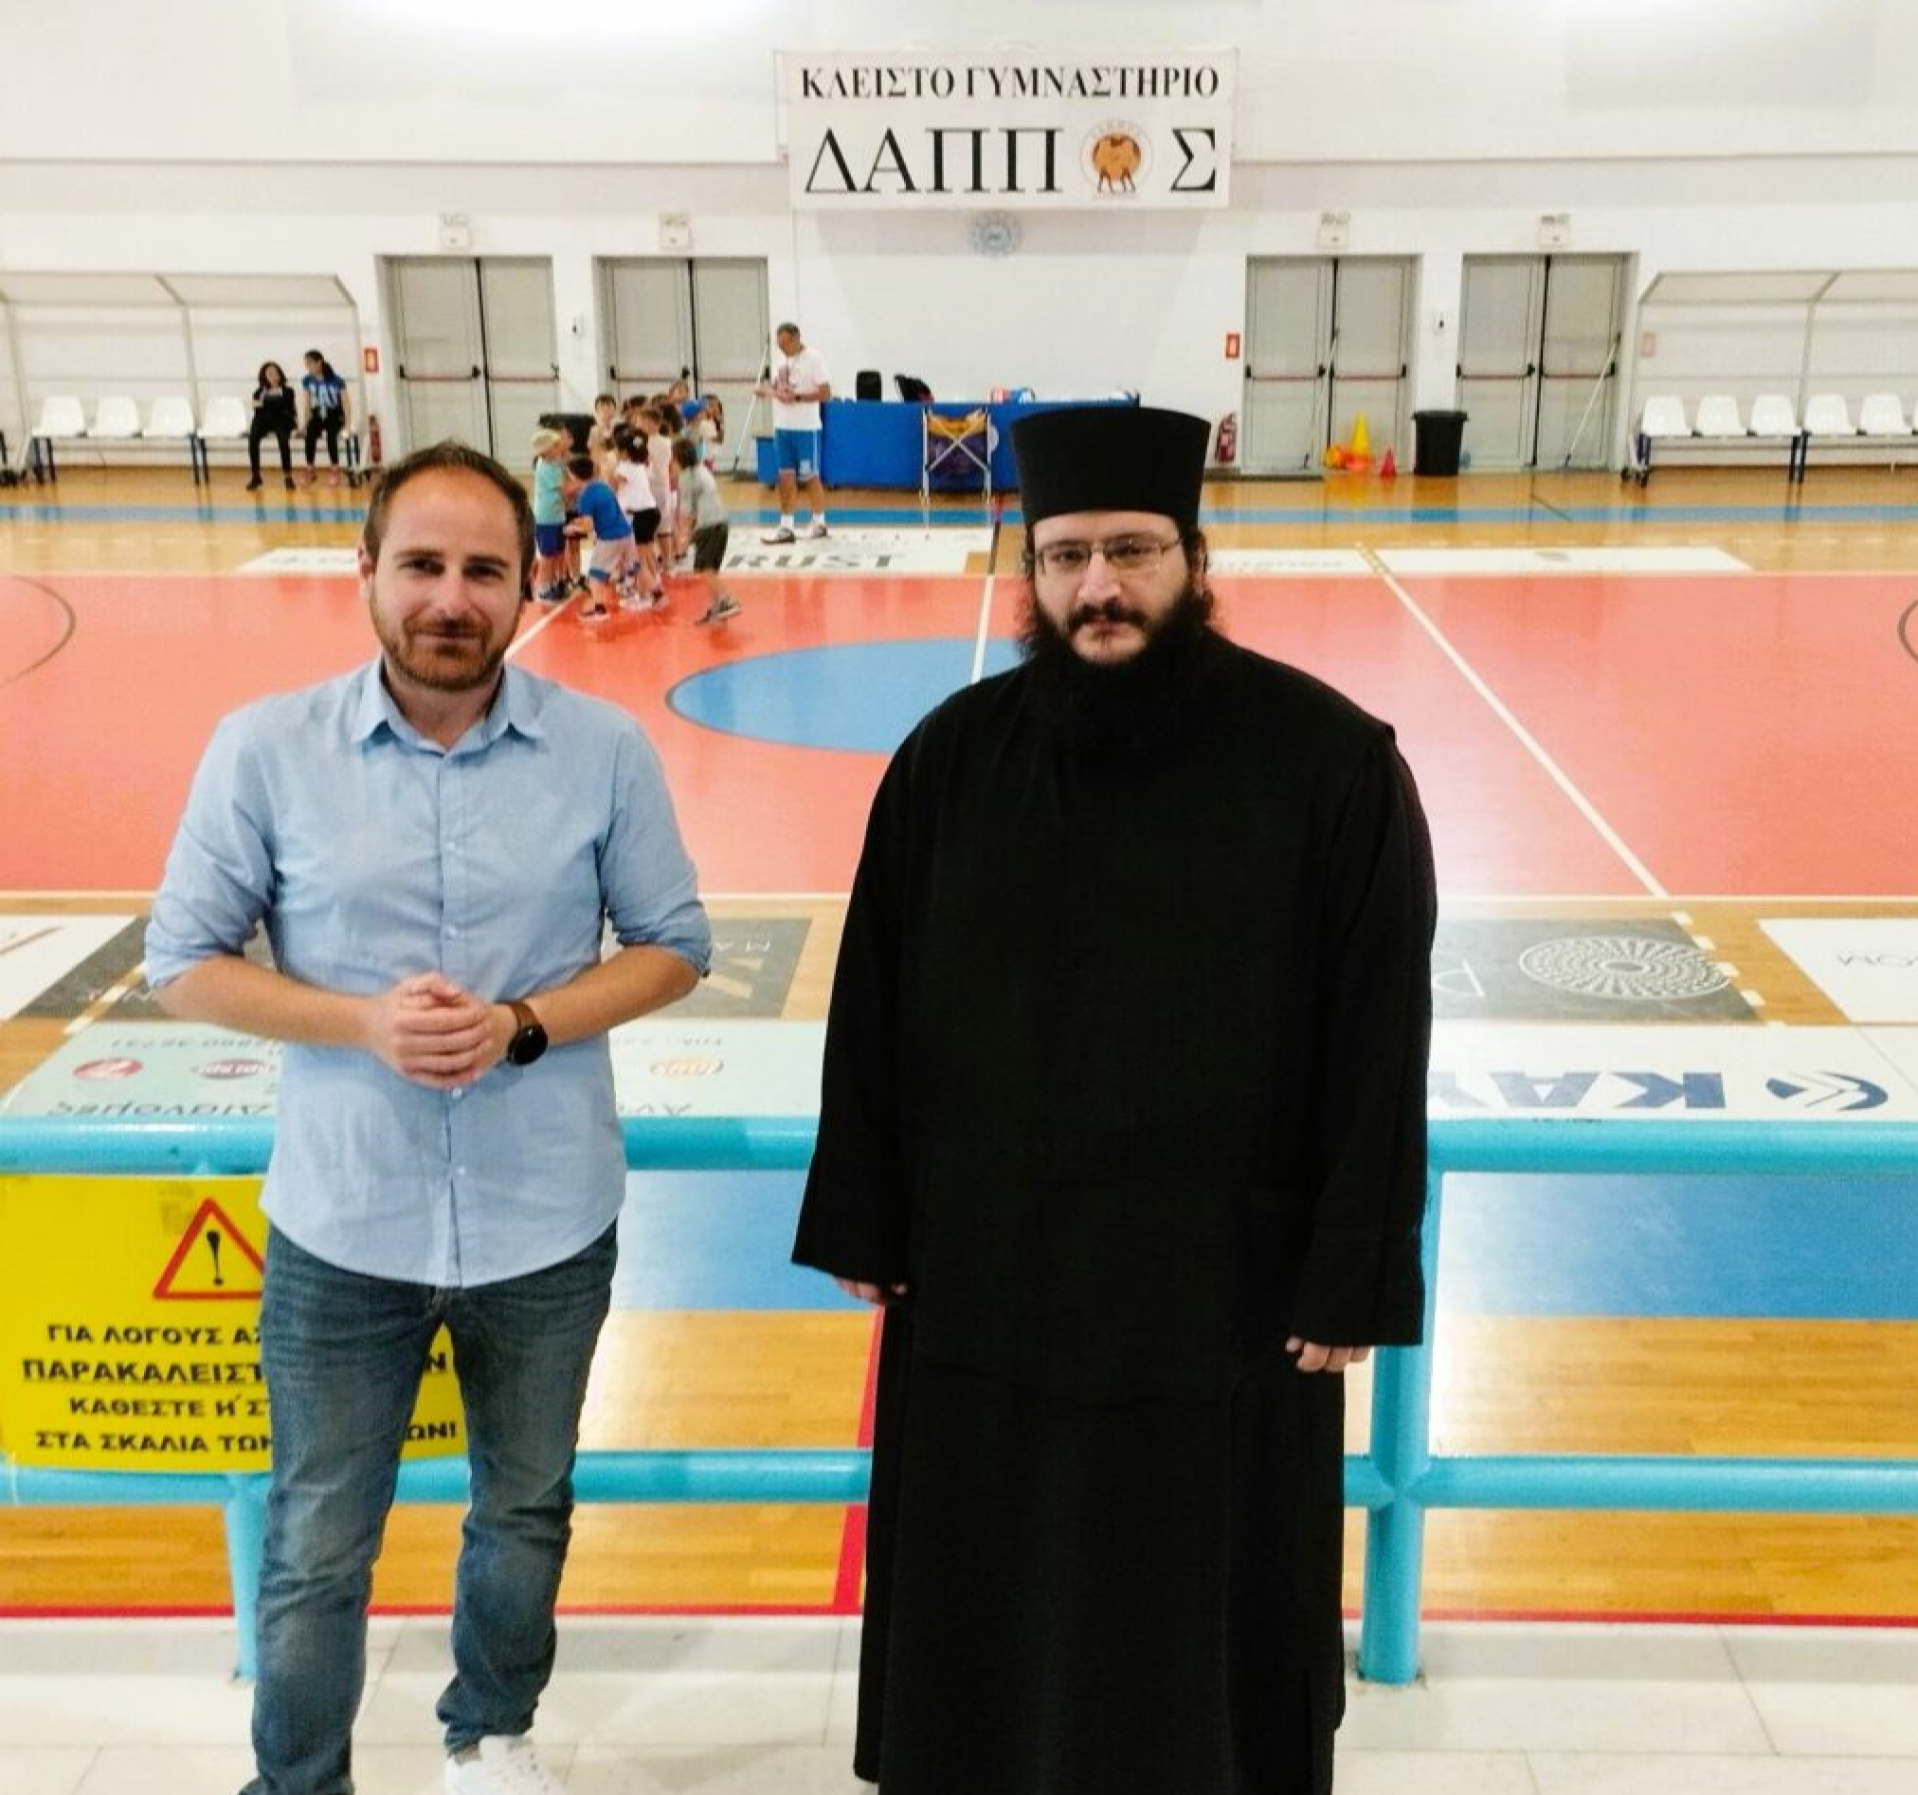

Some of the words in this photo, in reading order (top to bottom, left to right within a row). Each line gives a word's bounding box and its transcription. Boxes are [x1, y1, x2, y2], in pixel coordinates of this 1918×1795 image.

[801, 67, 955, 99] ΚΛΕΙΣΤΟ
[966, 66, 1219, 98] ΓΥΜΝΑΣΤΗΡΙΟ
[47, 1325, 94, 1343] ΓΙΑ
[104, 1326, 223, 1346] ΛΟΓΟΥΣ
[22, 1359, 263, 1383] ΠΑΡΑΚΑΛΕΙΣΤ
[69, 1398, 206, 1417] ΚΑΘΕΣΤΕ
[36, 1432, 90, 1449] ΣΤΑ
[99, 1433, 208, 1452] ΣΚΑΛΙΑ
